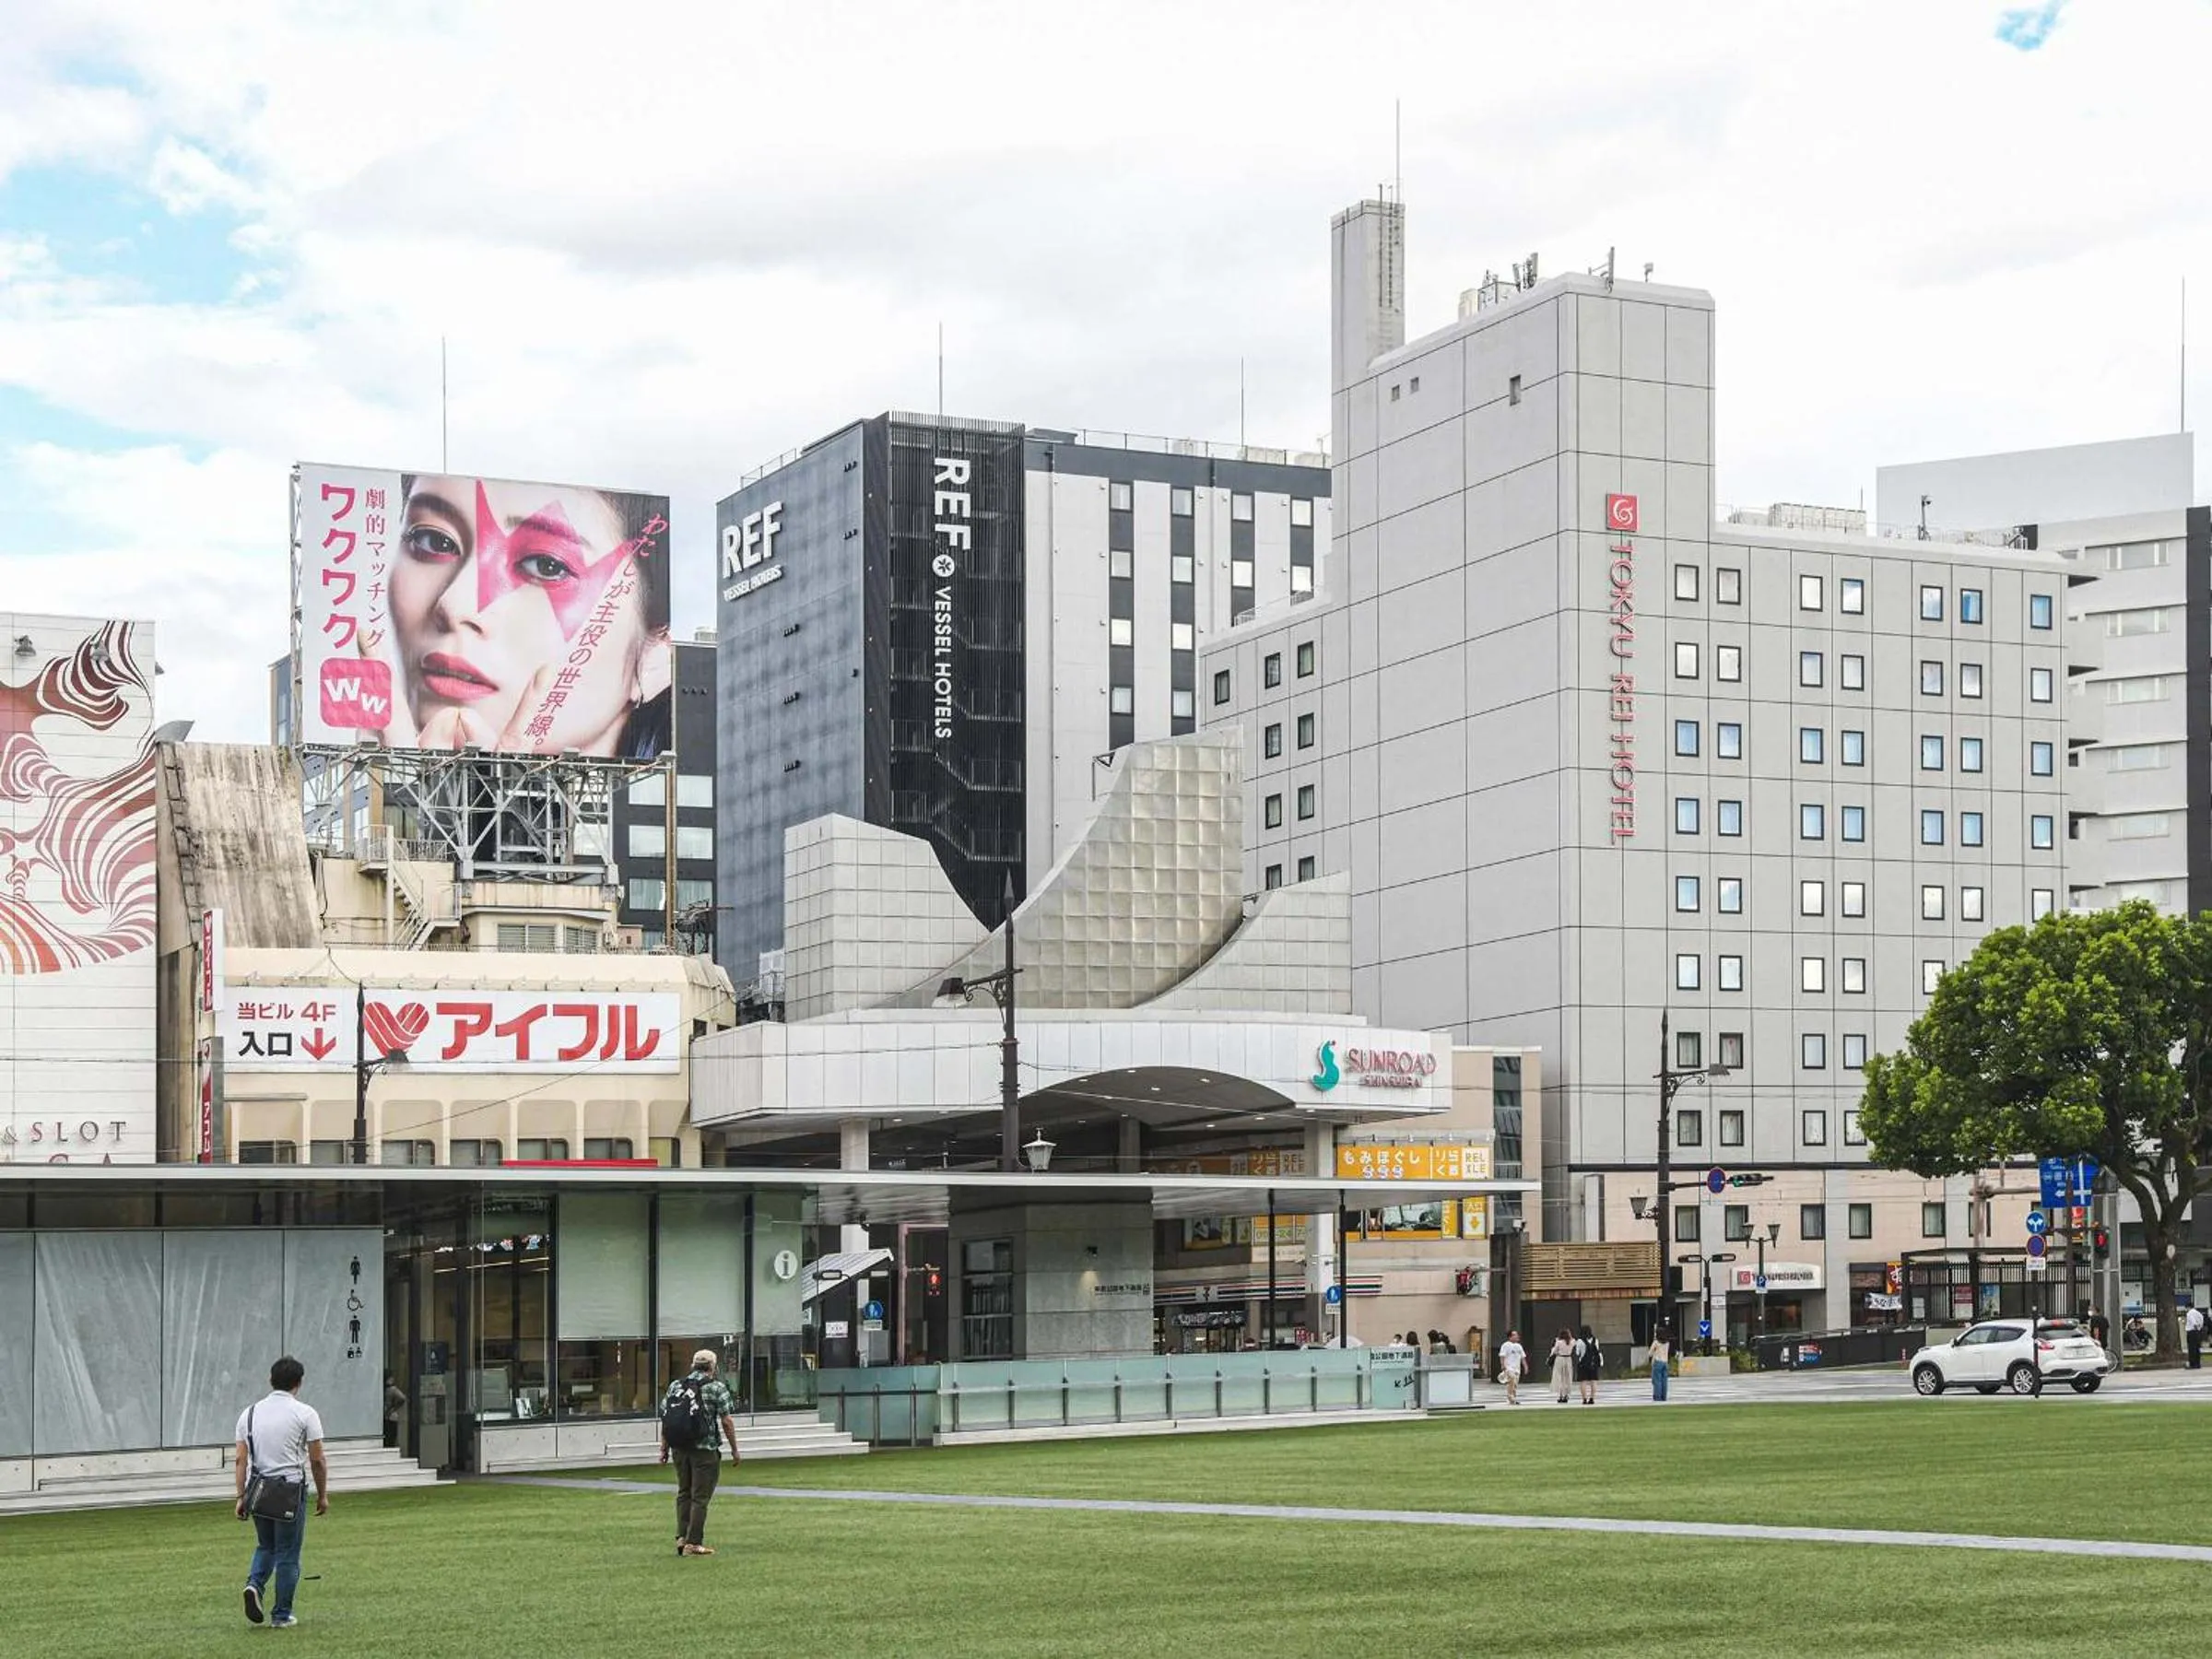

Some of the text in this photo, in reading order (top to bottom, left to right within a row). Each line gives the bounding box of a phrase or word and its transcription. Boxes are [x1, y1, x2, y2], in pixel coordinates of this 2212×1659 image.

[722, 500, 782, 579] REF
[934, 457, 971, 550] REF
[320, 483, 359, 649] ワクワク
[365, 488, 386, 647] 劇的マッチング
[524, 512, 669, 747] わたしが主役の世界線。
[934, 586, 952, 739] VESSEL HOTELS
[1609, 539, 1636, 845] TOKYU REI HOTEL
[237, 1001, 336, 1022] 当ビル 4F
[238, 1030, 293, 1057] 入口
[436, 1003, 661, 1061] アイフル
[1347, 1049, 1437, 1077] SUNROAD
[30, 1120, 127, 1144] SLOT
[1343, 1149, 1420, 1165] もみほぐし
